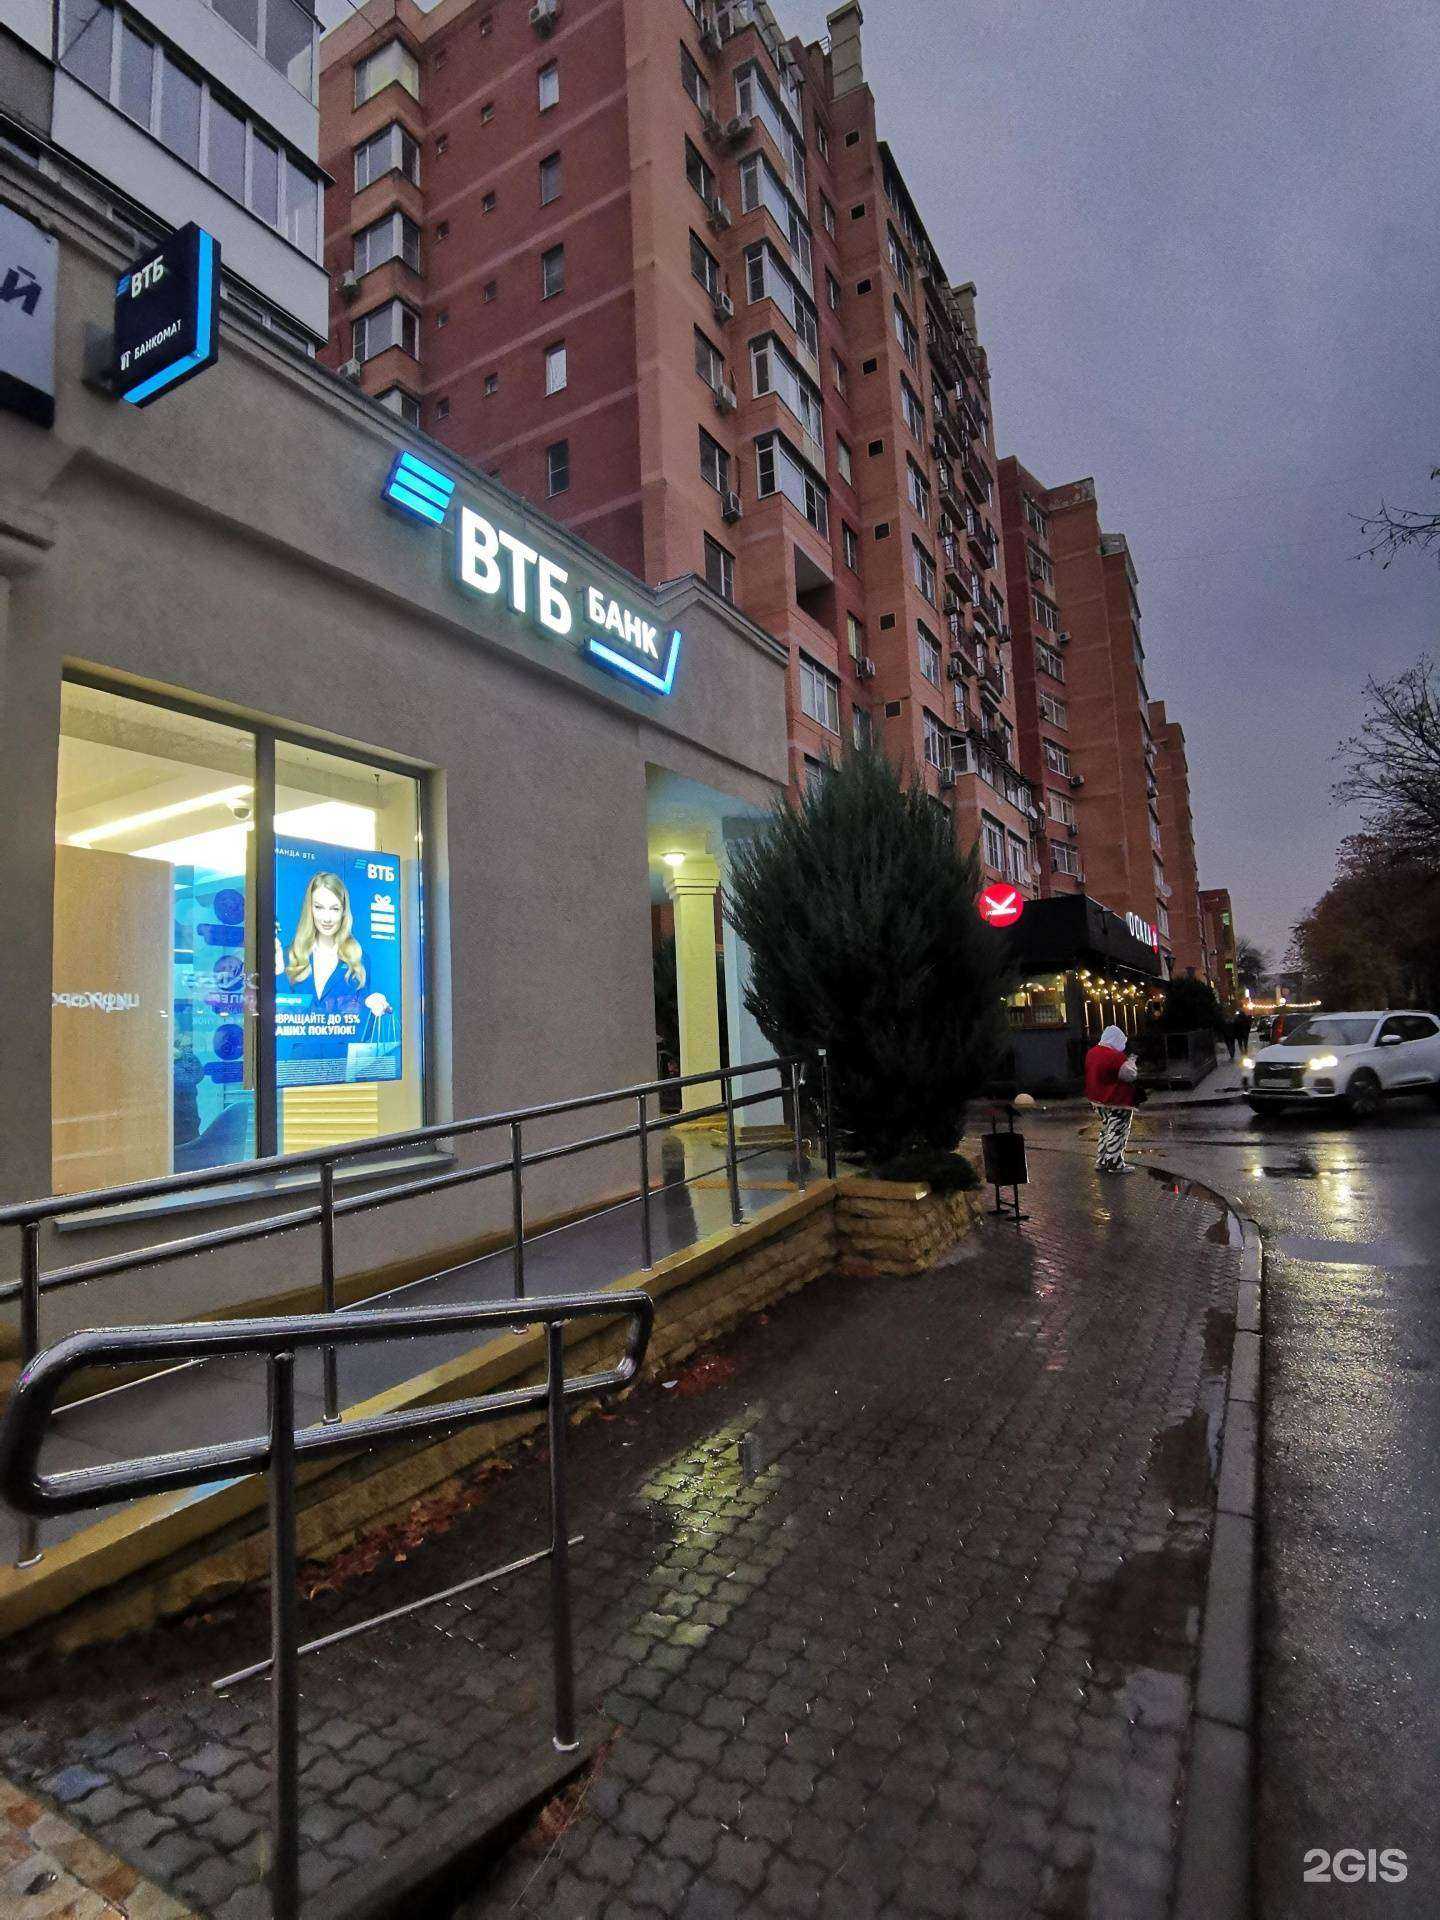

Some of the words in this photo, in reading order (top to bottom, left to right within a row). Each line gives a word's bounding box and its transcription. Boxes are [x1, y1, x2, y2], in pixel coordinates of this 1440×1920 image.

[131, 255, 164, 298] ВТБ
[134, 319, 182, 359] БАНКОМАТ
[461, 505, 572, 635] ВТБ
[588, 585, 659, 660] БАНК
[367, 863, 394, 882] ВТБ
[308, 1025, 356, 1036] ПОКУПОК!
[327, 1014, 342, 1026] ДО
[344, 1014, 361, 1024] 15%
